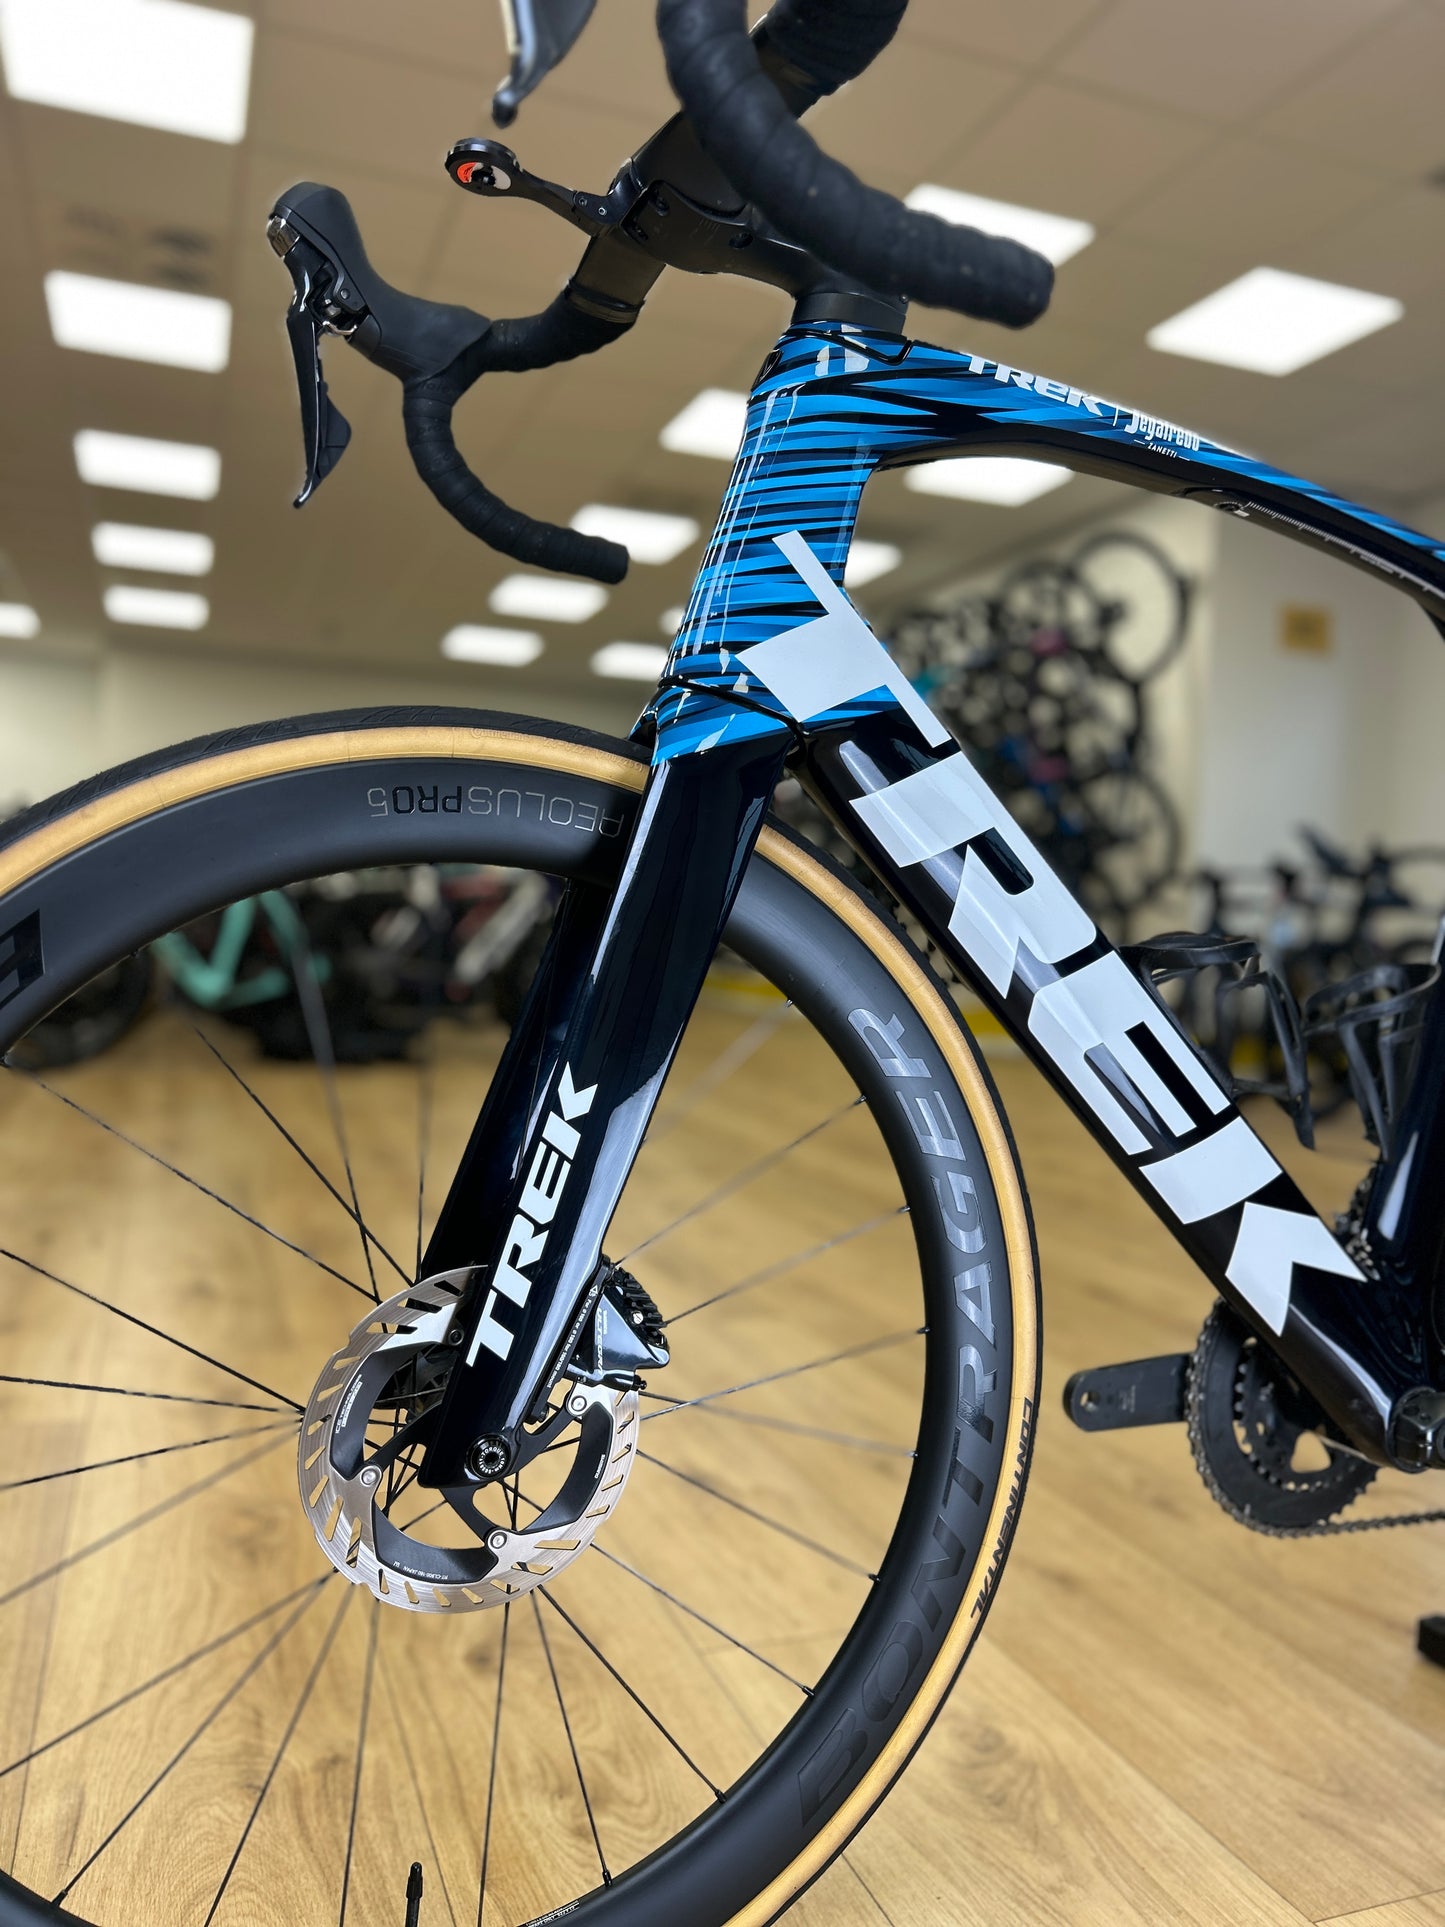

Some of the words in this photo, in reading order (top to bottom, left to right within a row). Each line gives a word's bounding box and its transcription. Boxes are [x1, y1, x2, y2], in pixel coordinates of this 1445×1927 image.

[965, 353, 1103, 417] TREK
[1147, 442, 1178, 458] ZANETTI
[735, 529, 1368, 1337] TREK
[466, 1061, 598, 1367] TREK
[798, 1006, 998, 1827] BONTRAGER
[971, 1397, 1034, 1619] CONTINENTAL
